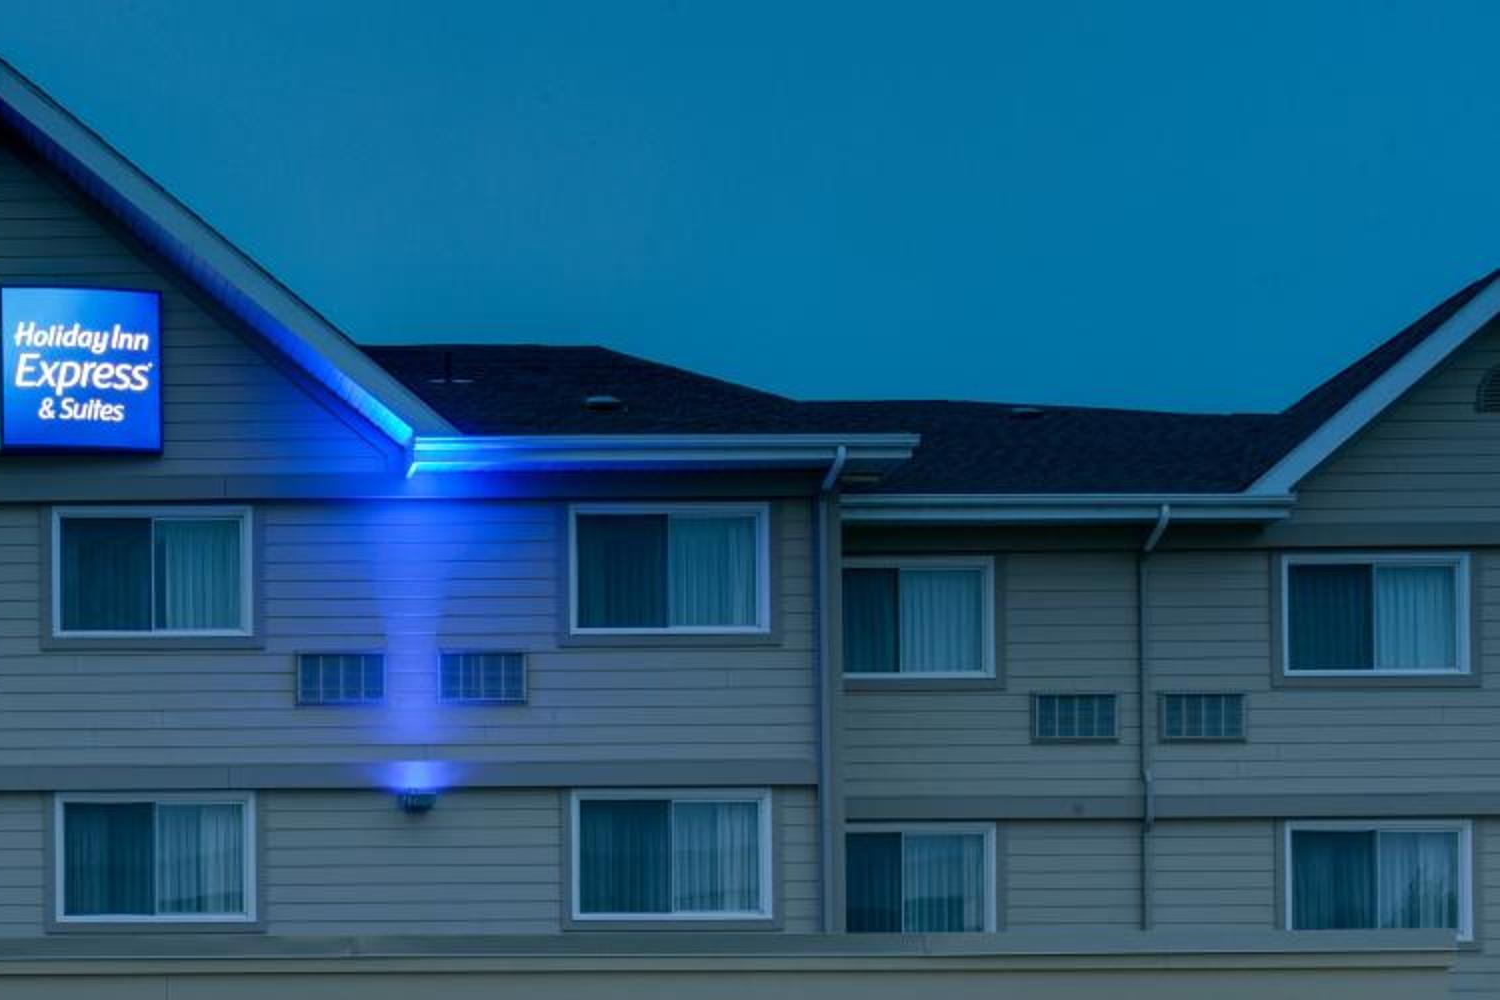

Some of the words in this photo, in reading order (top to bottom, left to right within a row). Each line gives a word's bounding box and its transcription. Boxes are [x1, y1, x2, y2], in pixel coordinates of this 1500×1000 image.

[15, 321, 108, 353] Holiday
[111, 324, 149, 351] Inn
[15, 352, 149, 395] Express
[38, 398, 55, 419] &
[59, 398, 125, 422] Suites
